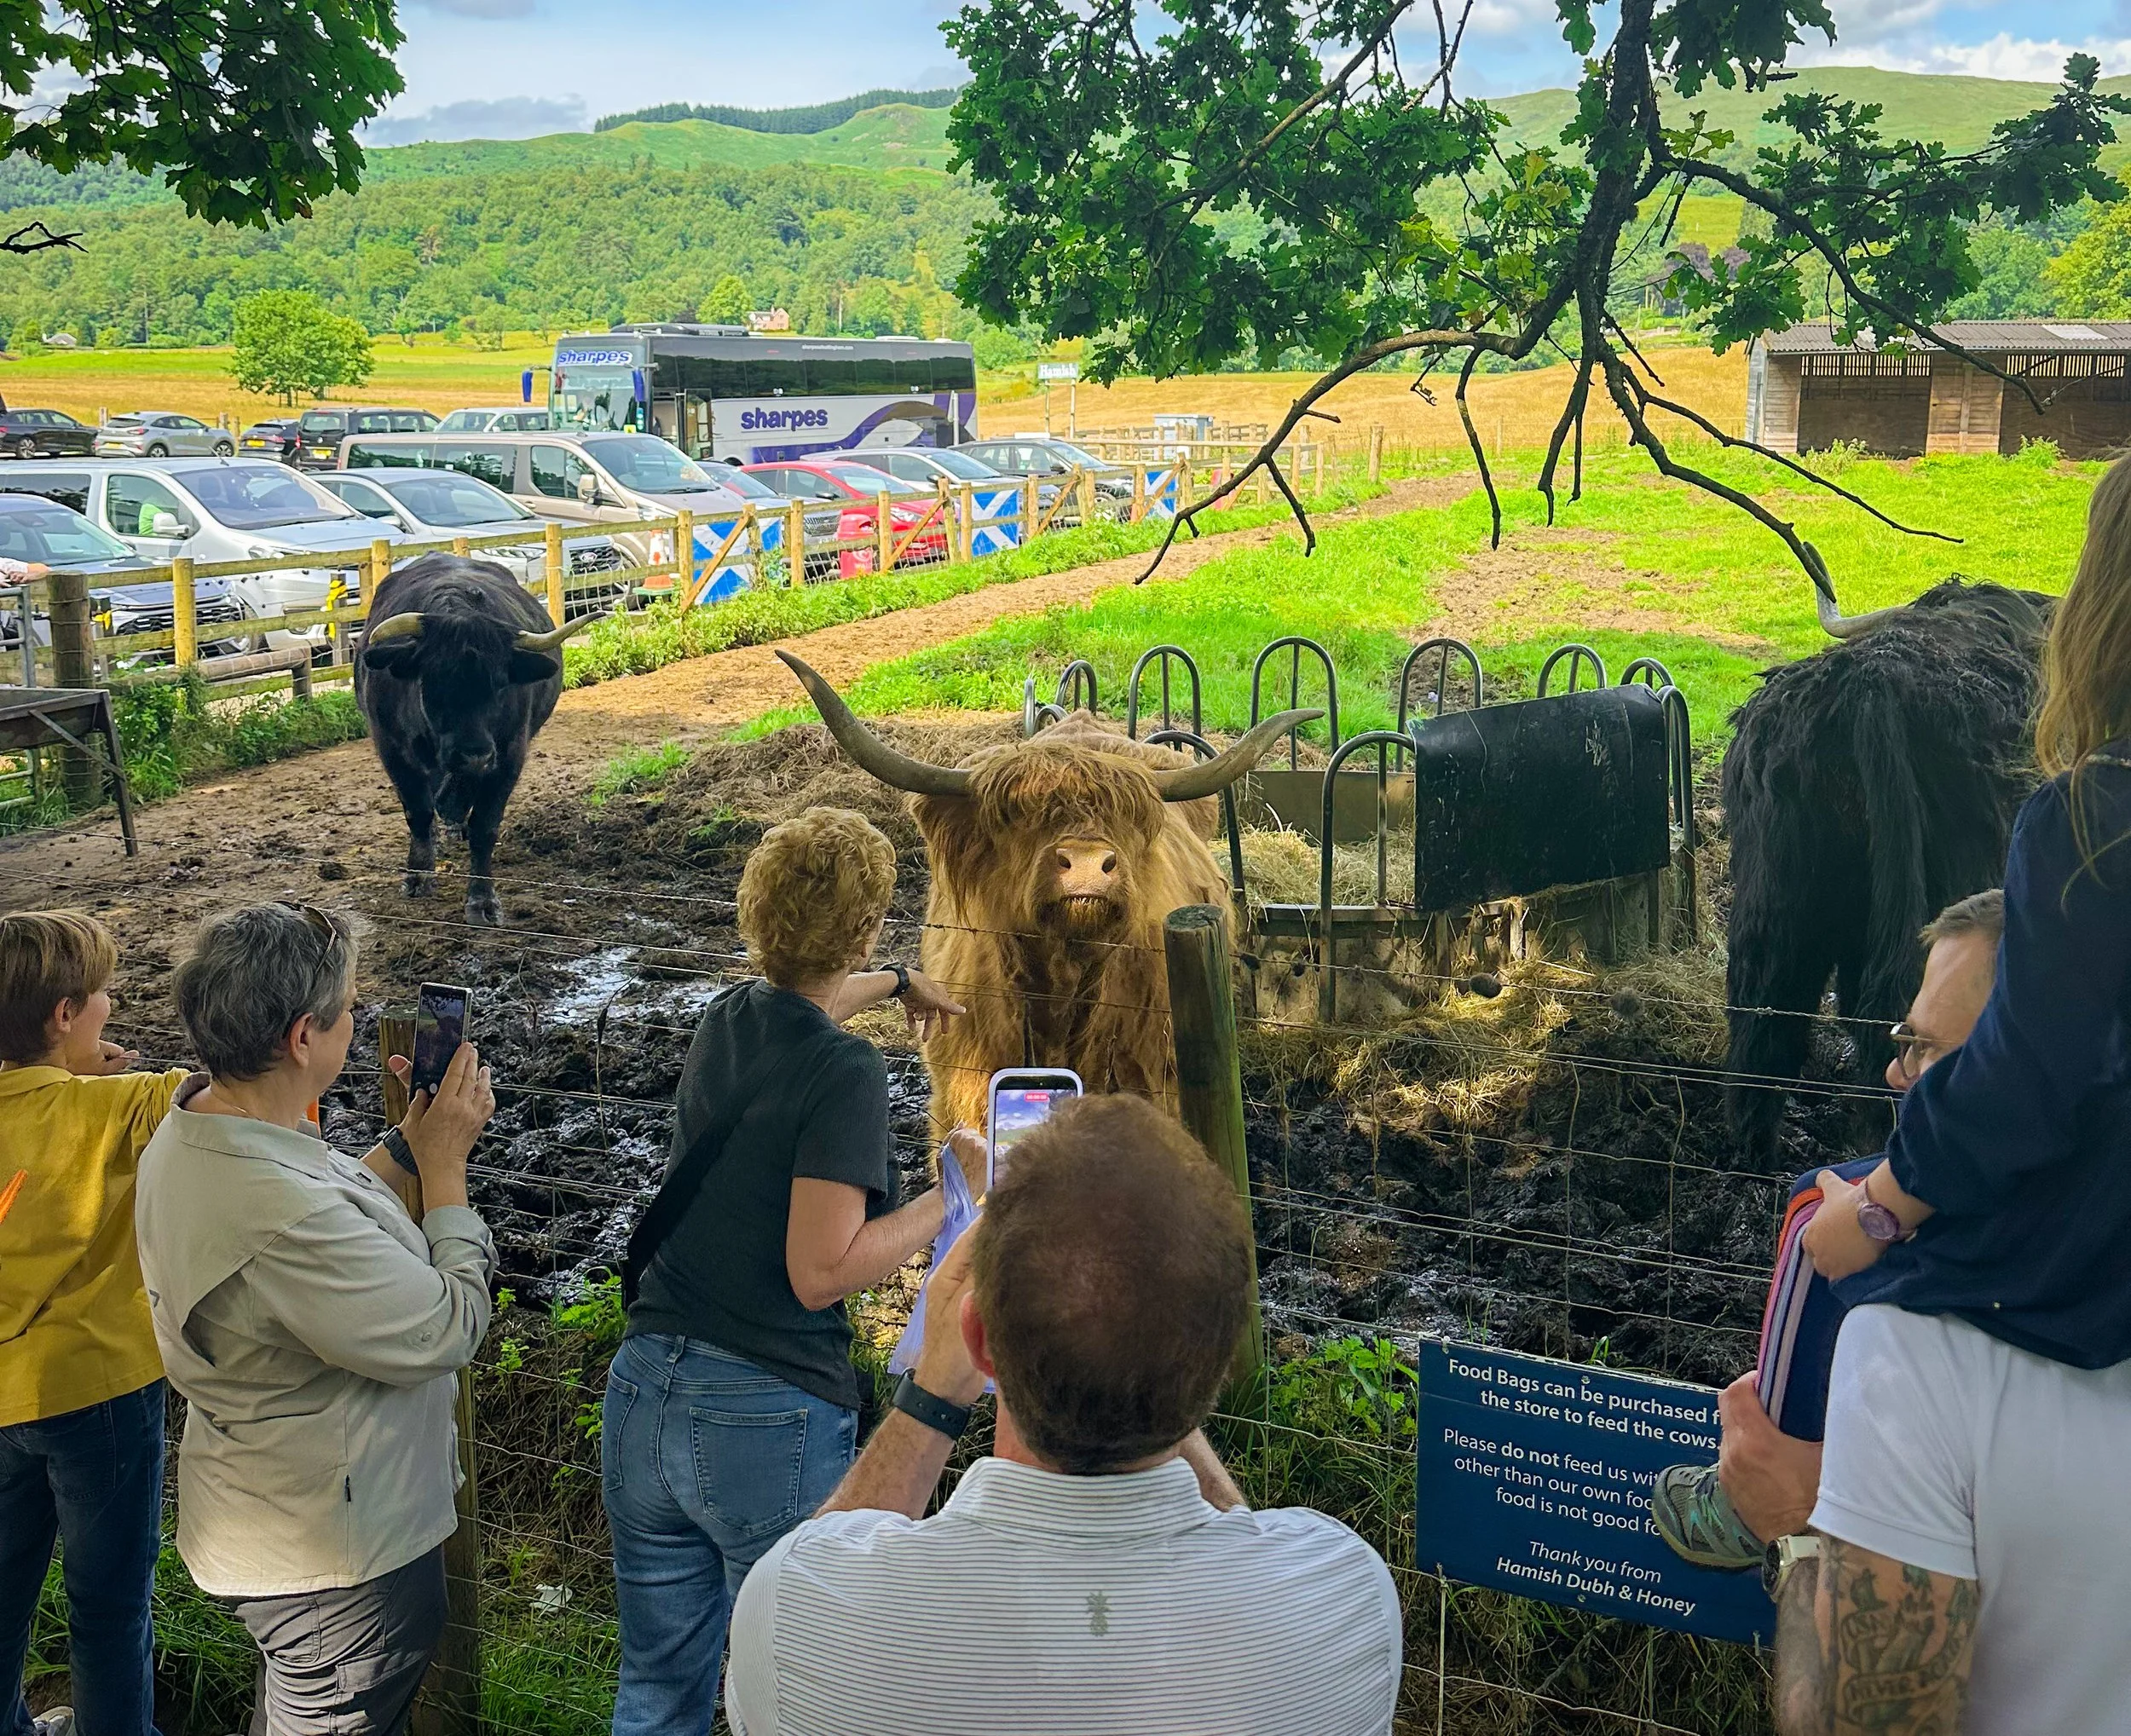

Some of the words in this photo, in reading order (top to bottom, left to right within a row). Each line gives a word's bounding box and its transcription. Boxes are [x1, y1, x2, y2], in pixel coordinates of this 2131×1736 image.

[558, 350, 631, 364] sharpes
[741, 407, 829, 432] sharpes
[1450, 1358, 1492, 1381] Food
[1497, 1369, 1539, 1393] Bags
[1544, 1382, 1575, 1399] can
[1580, 1386, 1604, 1404] be
[1608, 1395, 1707, 1423] purchased
[1481, 1390, 1510, 1410] the
[1515, 1399, 1560, 1419] store
[1563, 1408, 1583, 1424] to
[1588, 1410, 1628, 1433] feed
[1633, 1421, 1665, 1439] the
[1444, 1428, 1497, 1453] Please
[1501, 1442, 1524, 1459] do
[1529, 1451, 1560, 1467] not
[1563, 1454, 1603, 1475] feed
[1608, 1467, 1628, 1481] us
[1454, 1457, 1500, 1477] other
[1504, 1466, 1543, 1487] than
[1548, 1479, 1579, 1494] our
[1582, 1485, 1620, 1503] own
[1626, 1491, 1654, 1510] foo
[1496, 1487, 1535, 1509] food
[1540, 1497, 1553, 1513] is
[1558, 1504, 1588, 1520] not
[1592, 1511, 1639, 1531] good
[1644, 1519, 1661, 1536] fo
[1530, 1541, 1582, 1566] Thank
[1583, 1556, 1616, 1573] you
[1620, 1561, 1661, 1583] from
[1497, 1557, 1562, 1584] Hamish
[1567, 1573, 1614, 1596] Dubh
[1618, 1585, 1633, 1600] &
[1637, 1589, 1696, 1617] Honey
